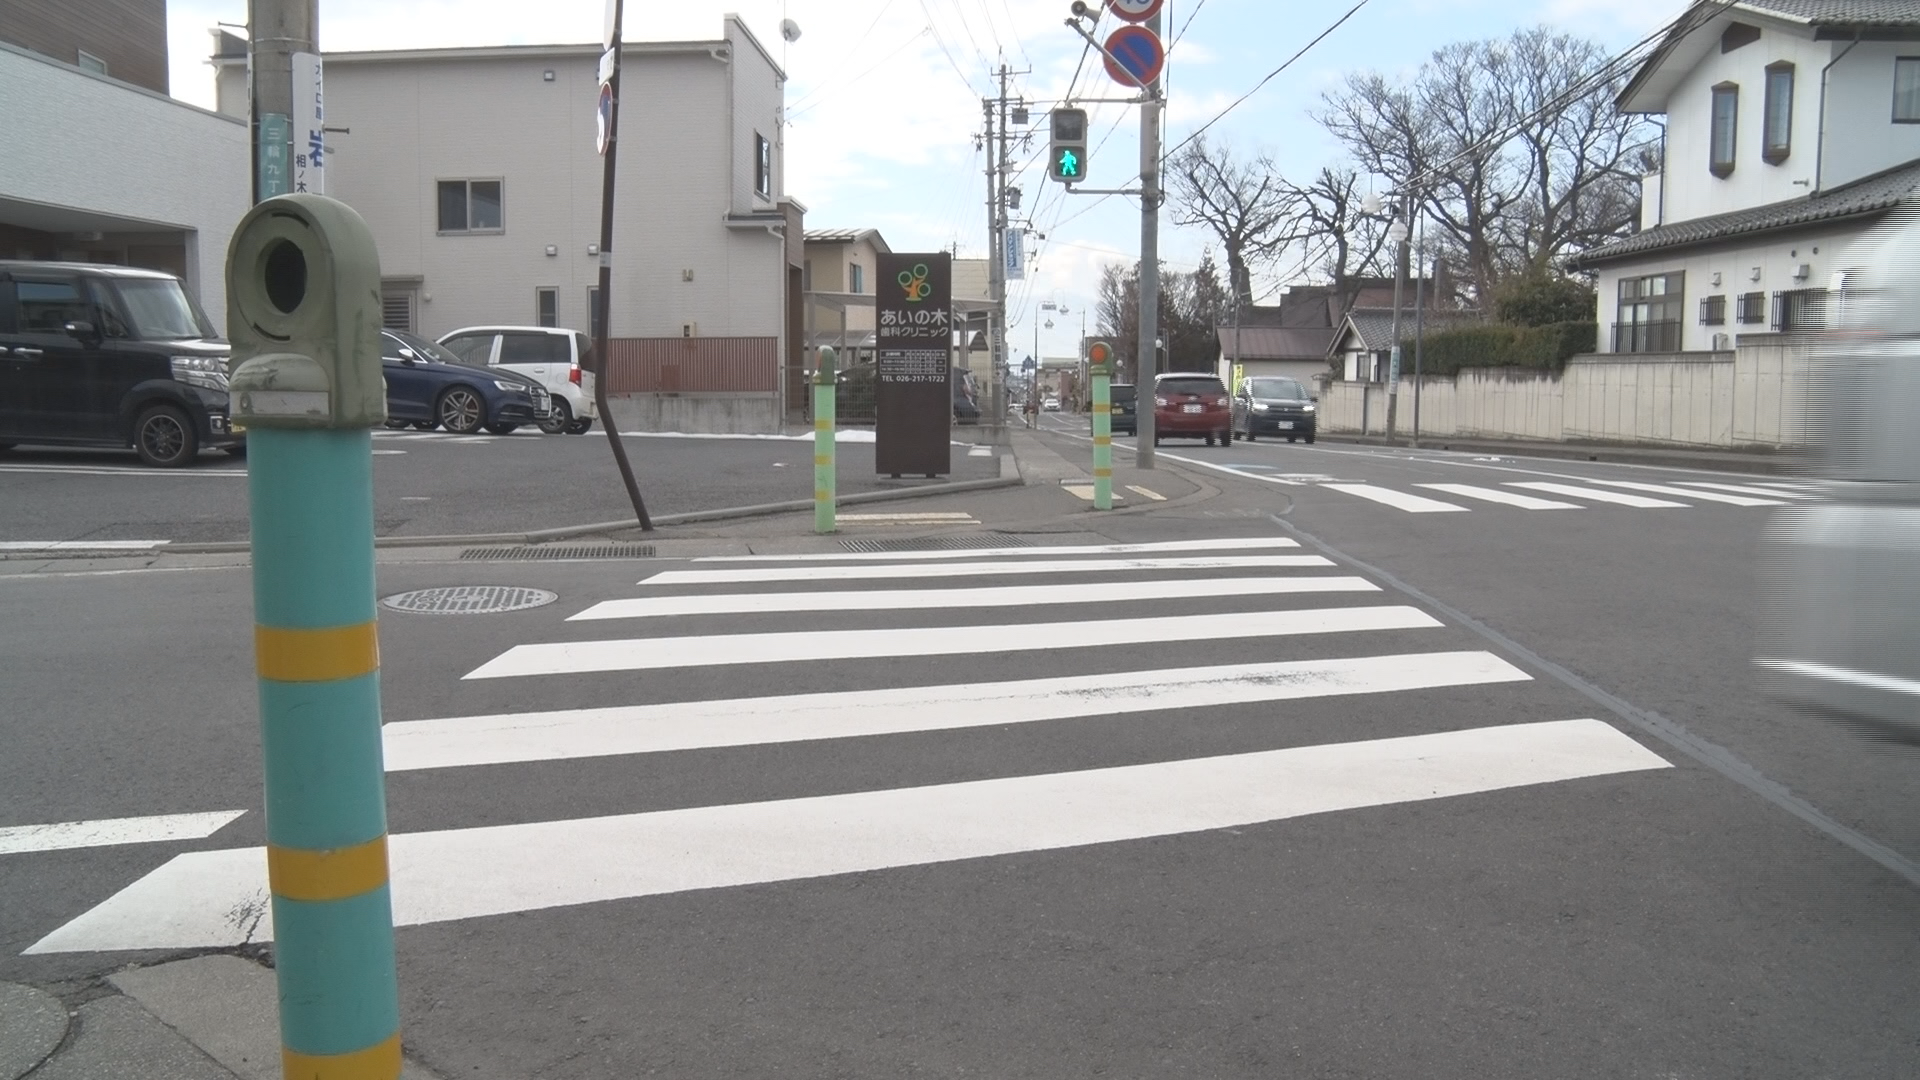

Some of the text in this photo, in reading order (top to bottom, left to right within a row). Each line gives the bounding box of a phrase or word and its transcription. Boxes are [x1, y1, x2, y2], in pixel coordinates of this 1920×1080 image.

[880, 307, 948, 326] あいの木
[880, 326, 949, 338] 歯科クリニック
